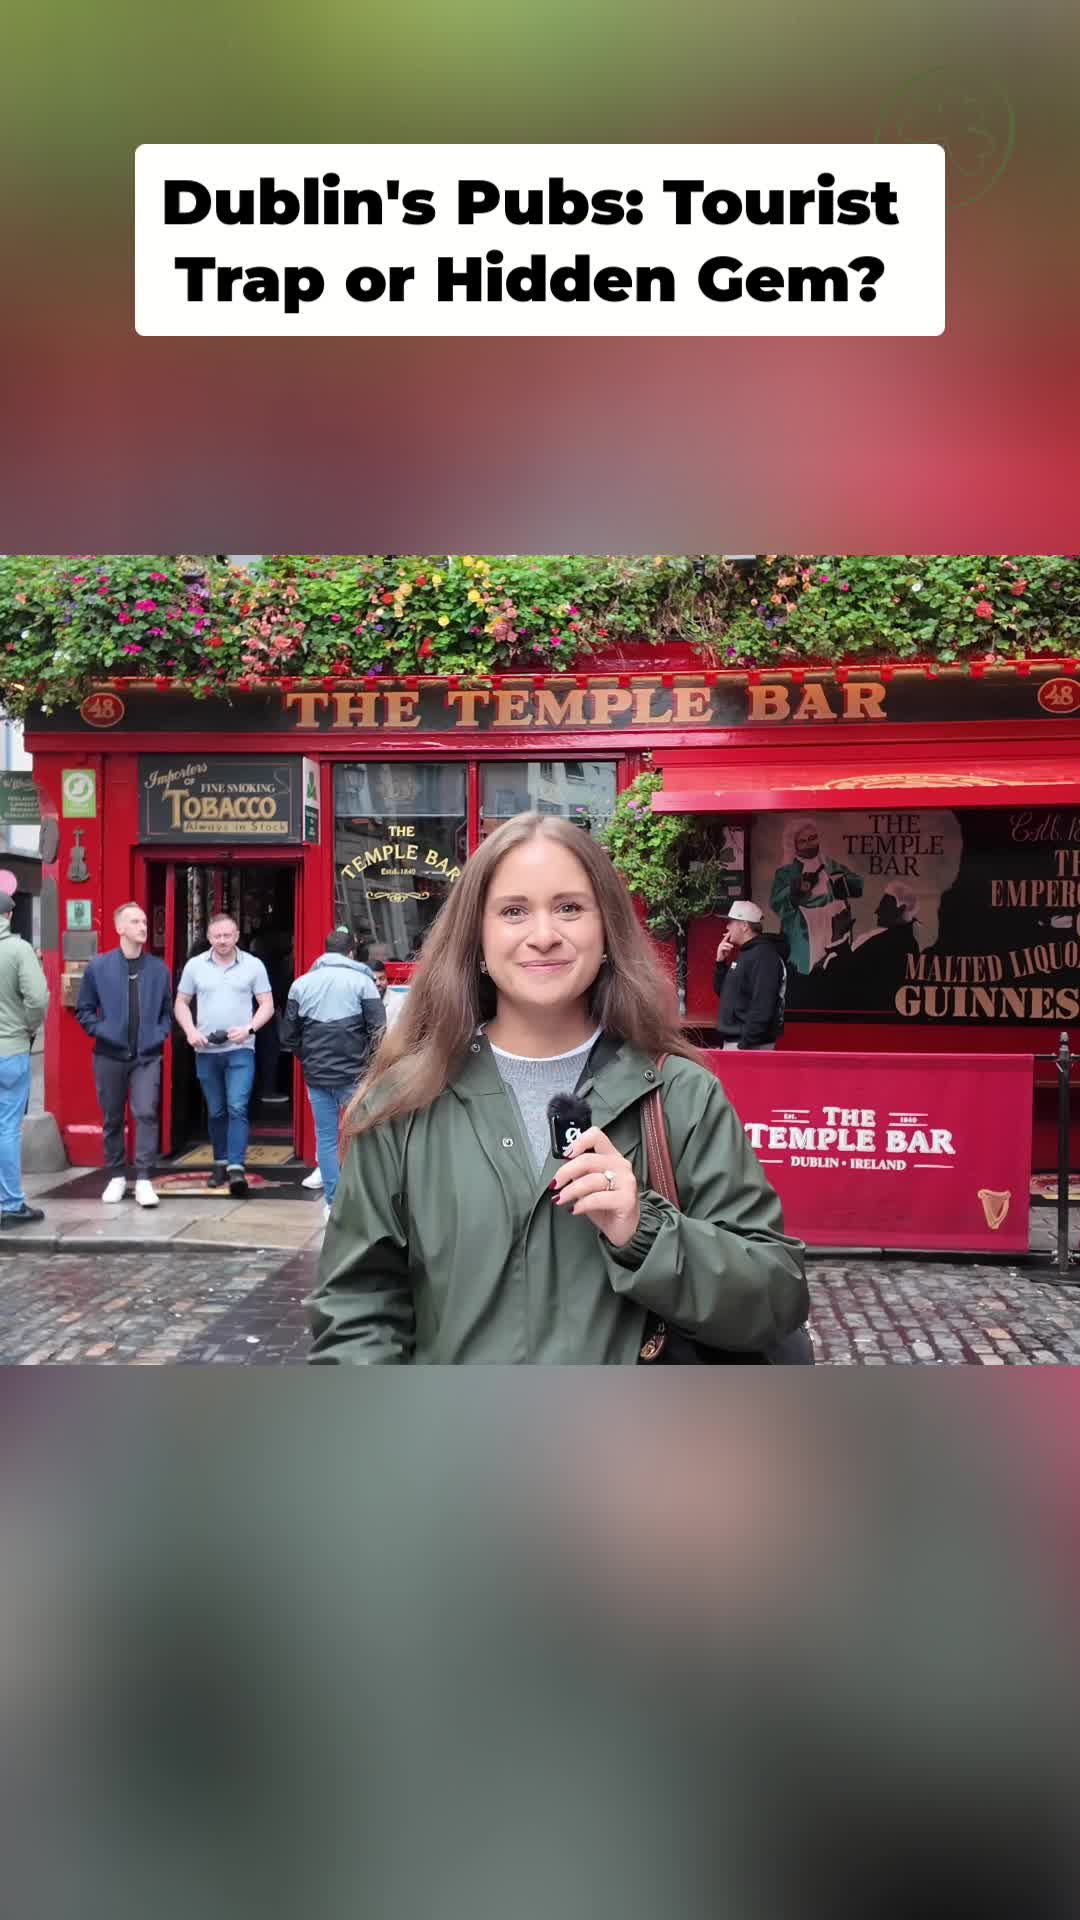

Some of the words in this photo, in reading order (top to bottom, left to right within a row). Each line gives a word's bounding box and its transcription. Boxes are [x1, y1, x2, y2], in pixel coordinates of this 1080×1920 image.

[286, 691, 421, 729] THE
[448, 687, 714, 728] TEMPLE
[748, 682, 888, 721] BAR
[1044, 684, 1074, 706] 48
[88, 700, 115, 719] 48
[144, 762, 208, 791] Importers
[201, 784, 225, 793] FINE
[227, 784, 276, 793] SMOKING
[162, 789, 277, 830] TOBACCO
[185, 822, 228, 832] Always
[234, 822, 246, 832] in
[251, 821, 286, 832] Stock
[388, 825, 415, 838] THE
[868, 814, 921, 835] THE
[842, 835, 945, 856] TEMPLE
[341, 844, 419, 881] TEMPLE
[424, 849, 462, 884] BAR
[869, 856, 921, 877] BAR
[991, 879, 1080, 908] EMPER
[904, 952, 1003, 984] MALTED
[1008, 940, 1080, 979] LIQUO
[894, 985, 1080, 1020] GUINNES
[822, 1106, 876, 1128] THE
[744, 1122, 876, 1153] TEMPLE
[886, 1128, 956, 1155] BAR
[790, 1156, 839, 1169] DUBLIN
[849, 1158, 907, 1172] IRELAND
